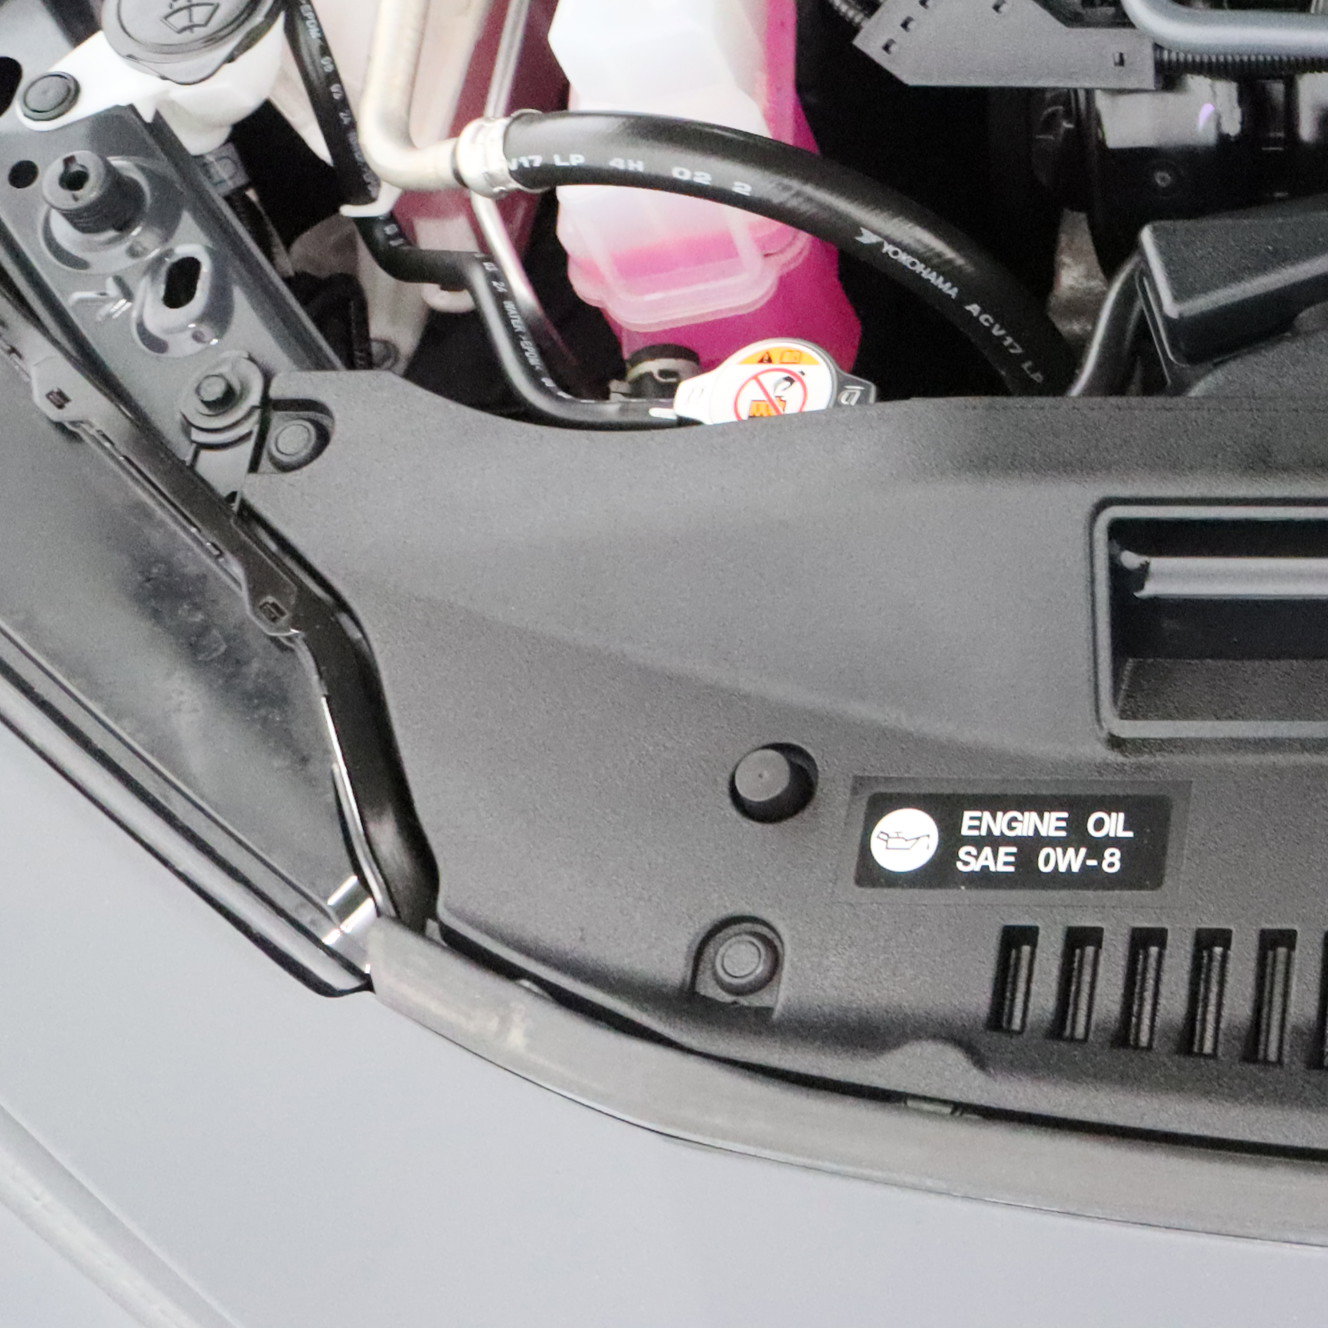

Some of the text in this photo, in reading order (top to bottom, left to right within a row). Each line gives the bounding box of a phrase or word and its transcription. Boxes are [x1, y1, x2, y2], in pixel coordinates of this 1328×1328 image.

[553, 154, 586, 167] LP
[609, 157, 645, 173] 4H
[882, 240, 960, 300] YOKOHAMA
[964, 303, 1024, 355] ACV17
[960, 810, 1135, 839] ENGINE OIL
[955, 845, 1122, 874] SAE 0W-8
